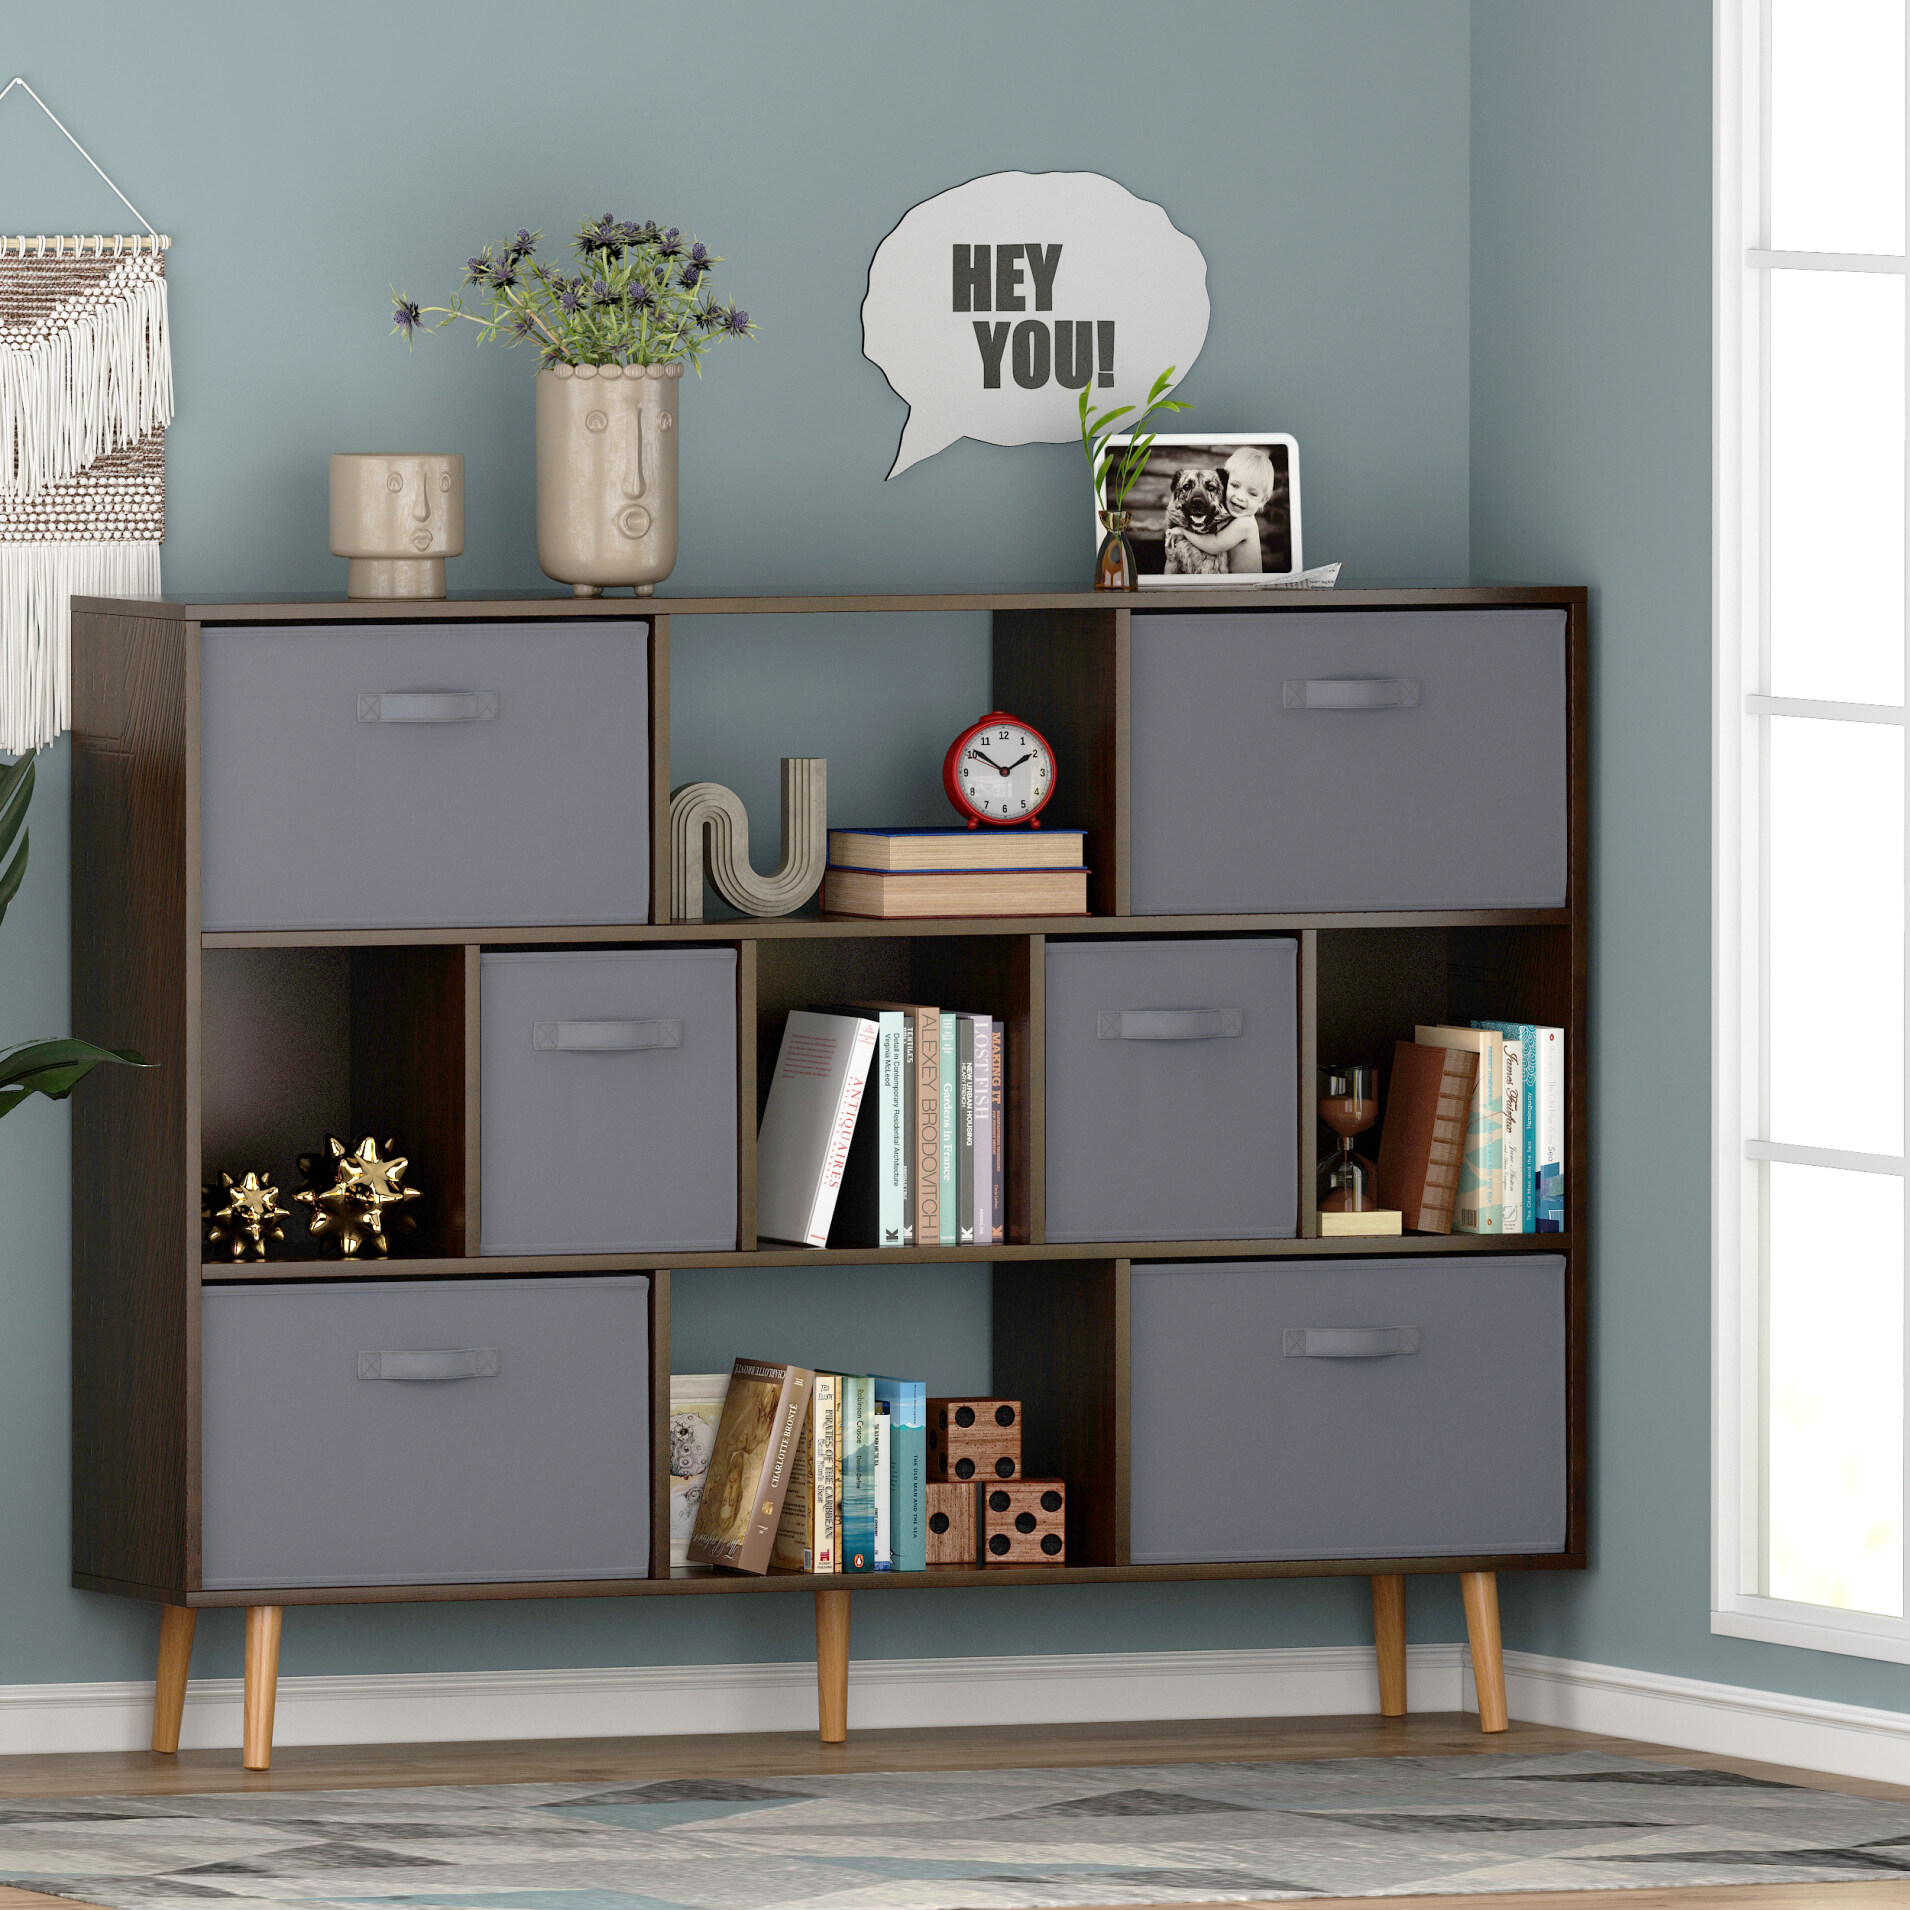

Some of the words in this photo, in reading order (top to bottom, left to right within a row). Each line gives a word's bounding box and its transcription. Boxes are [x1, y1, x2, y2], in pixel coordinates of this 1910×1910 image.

[953, 243, 1064, 313] HEY
[972, 319, 1116, 390] YOU!
[981, 737, 991, 746] 11
[998, 731, 1010, 740] 12
[1020, 737, 1026, 746] 1
[967, 750, 978, 760] 10
[1032, 749, 1039, 758] 2
[963, 768, 969, 777] 9
[1040, 768, 1046, 777] 3
[969, 787, 976, 796] 8
[1034, 787, 1040, 796] 4
[984, 800, 990, 809] 7
[1002, 804, 1008, 813] 6
[1020, 800, 1027, 809] 5
[922, 1013, 938, 1092] ALEXEY
[974, 1022, 989, 1072] LOST
[992, 1031, 1002, 1087] MAKING
[1503, 1044, 1519, 1086] James
[891, 1061, 900, 1108] Contemporary
[943, 1082, 953, 1128] Gardens
[974, 1077, 989, 1119] FISH
[992, 1090, 1002, 1105] IT
[829, 1076, 864, 1189] ANTIQUAIRES
[943, 1130, 953, 1141] in
[922, 1098, 938, 1229] BRODOVITCH
[943, 1144, 953, 1181] France
[1547, 1146, 1556, 1162] Sea
[856, 1389, 865, 1419] Robinson
[823, 1409, 833, 1448] PIRATES
[856, 1420, 865, 1444] Crusoe
[770, 1438, 790, 1488] CHARLOTTE
[824, 1449, 833, 1463] OF
[824, 1465, 833, 1485] THE
[822, 1486, 833, 1539] CARIBBEAN
